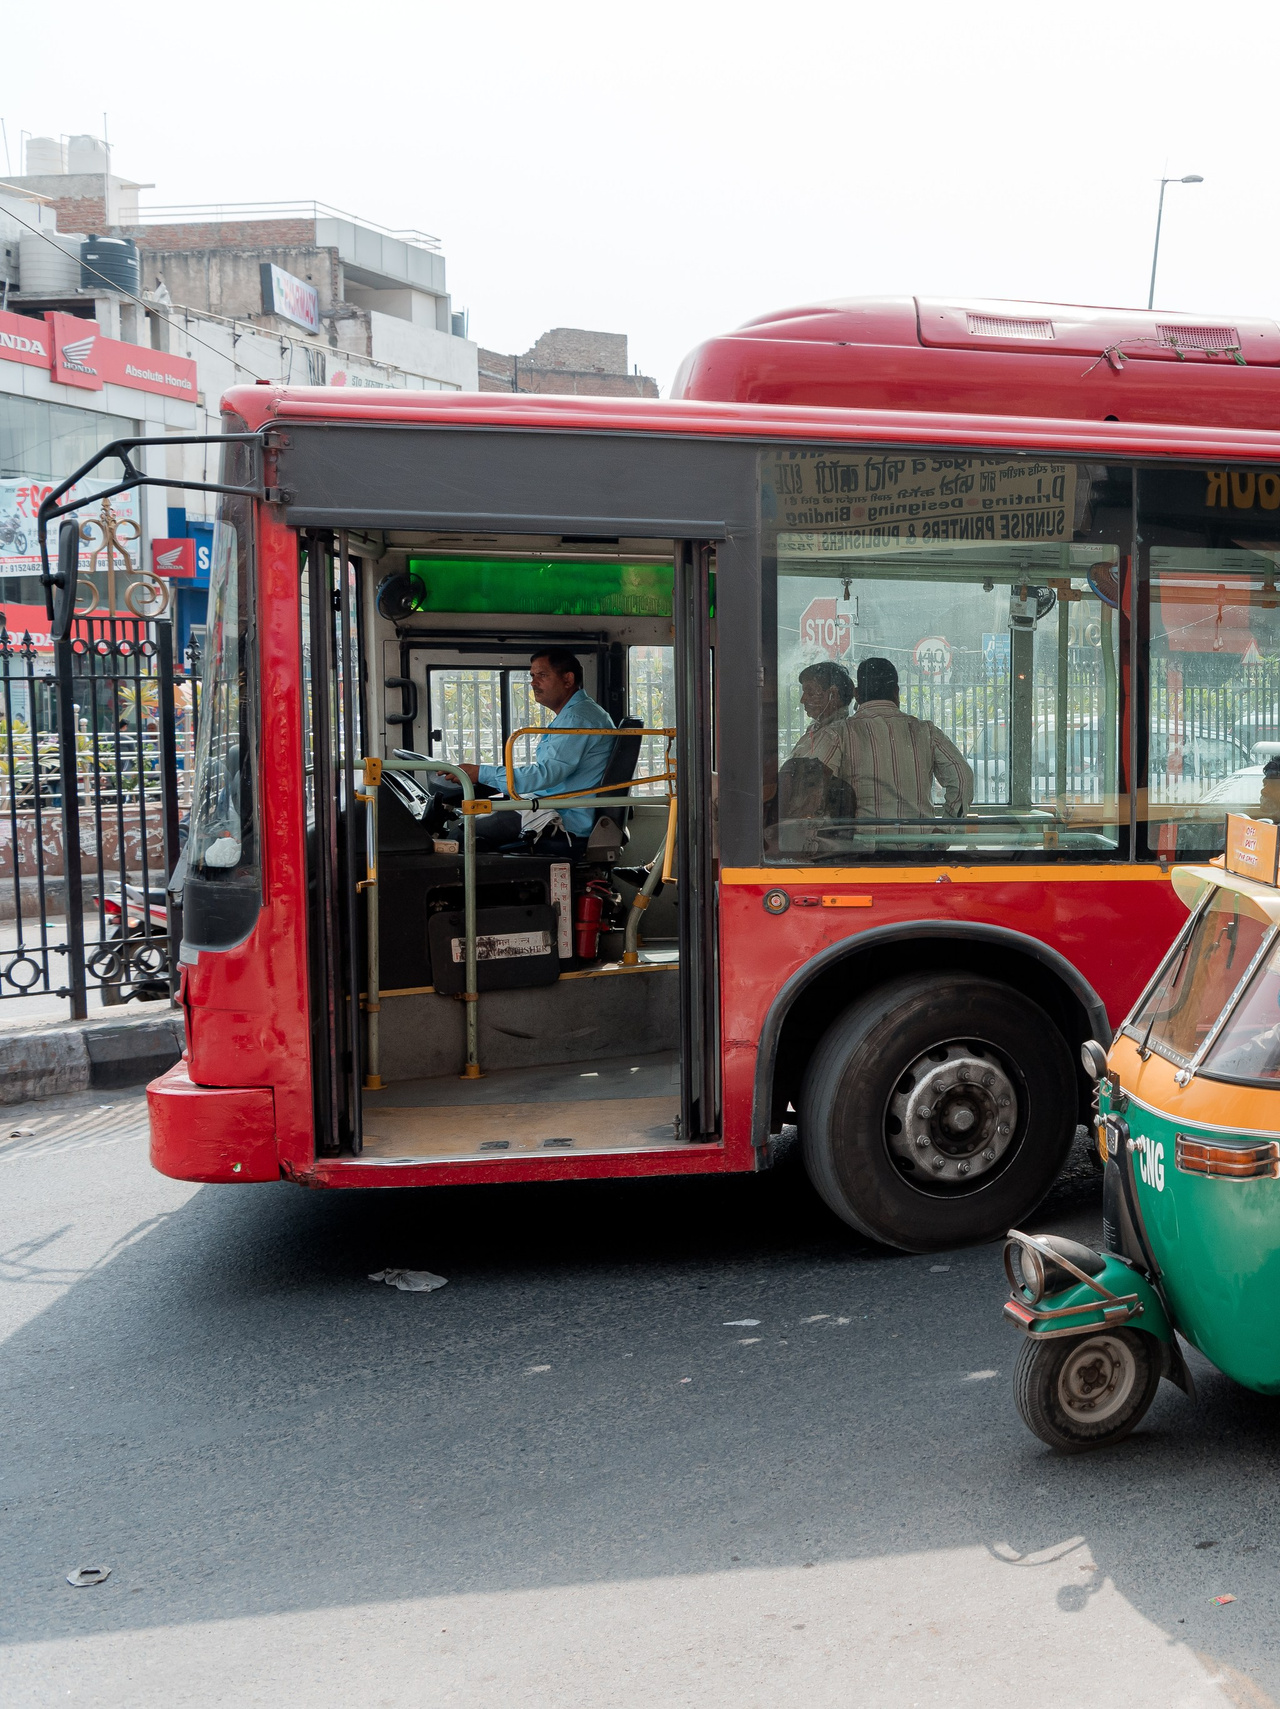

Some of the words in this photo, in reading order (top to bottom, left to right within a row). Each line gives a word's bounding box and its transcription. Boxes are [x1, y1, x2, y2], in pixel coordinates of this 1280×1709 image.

[62, 362, 97, 376] HONDA
[125, 364, 164, 383] Absolute
[165, 373, 192, 390] Honda
[806, 618, 846, 646] STOP
[922, 648, 945, 664] 40
[1139, 1134, 1165, 1192] CNG
